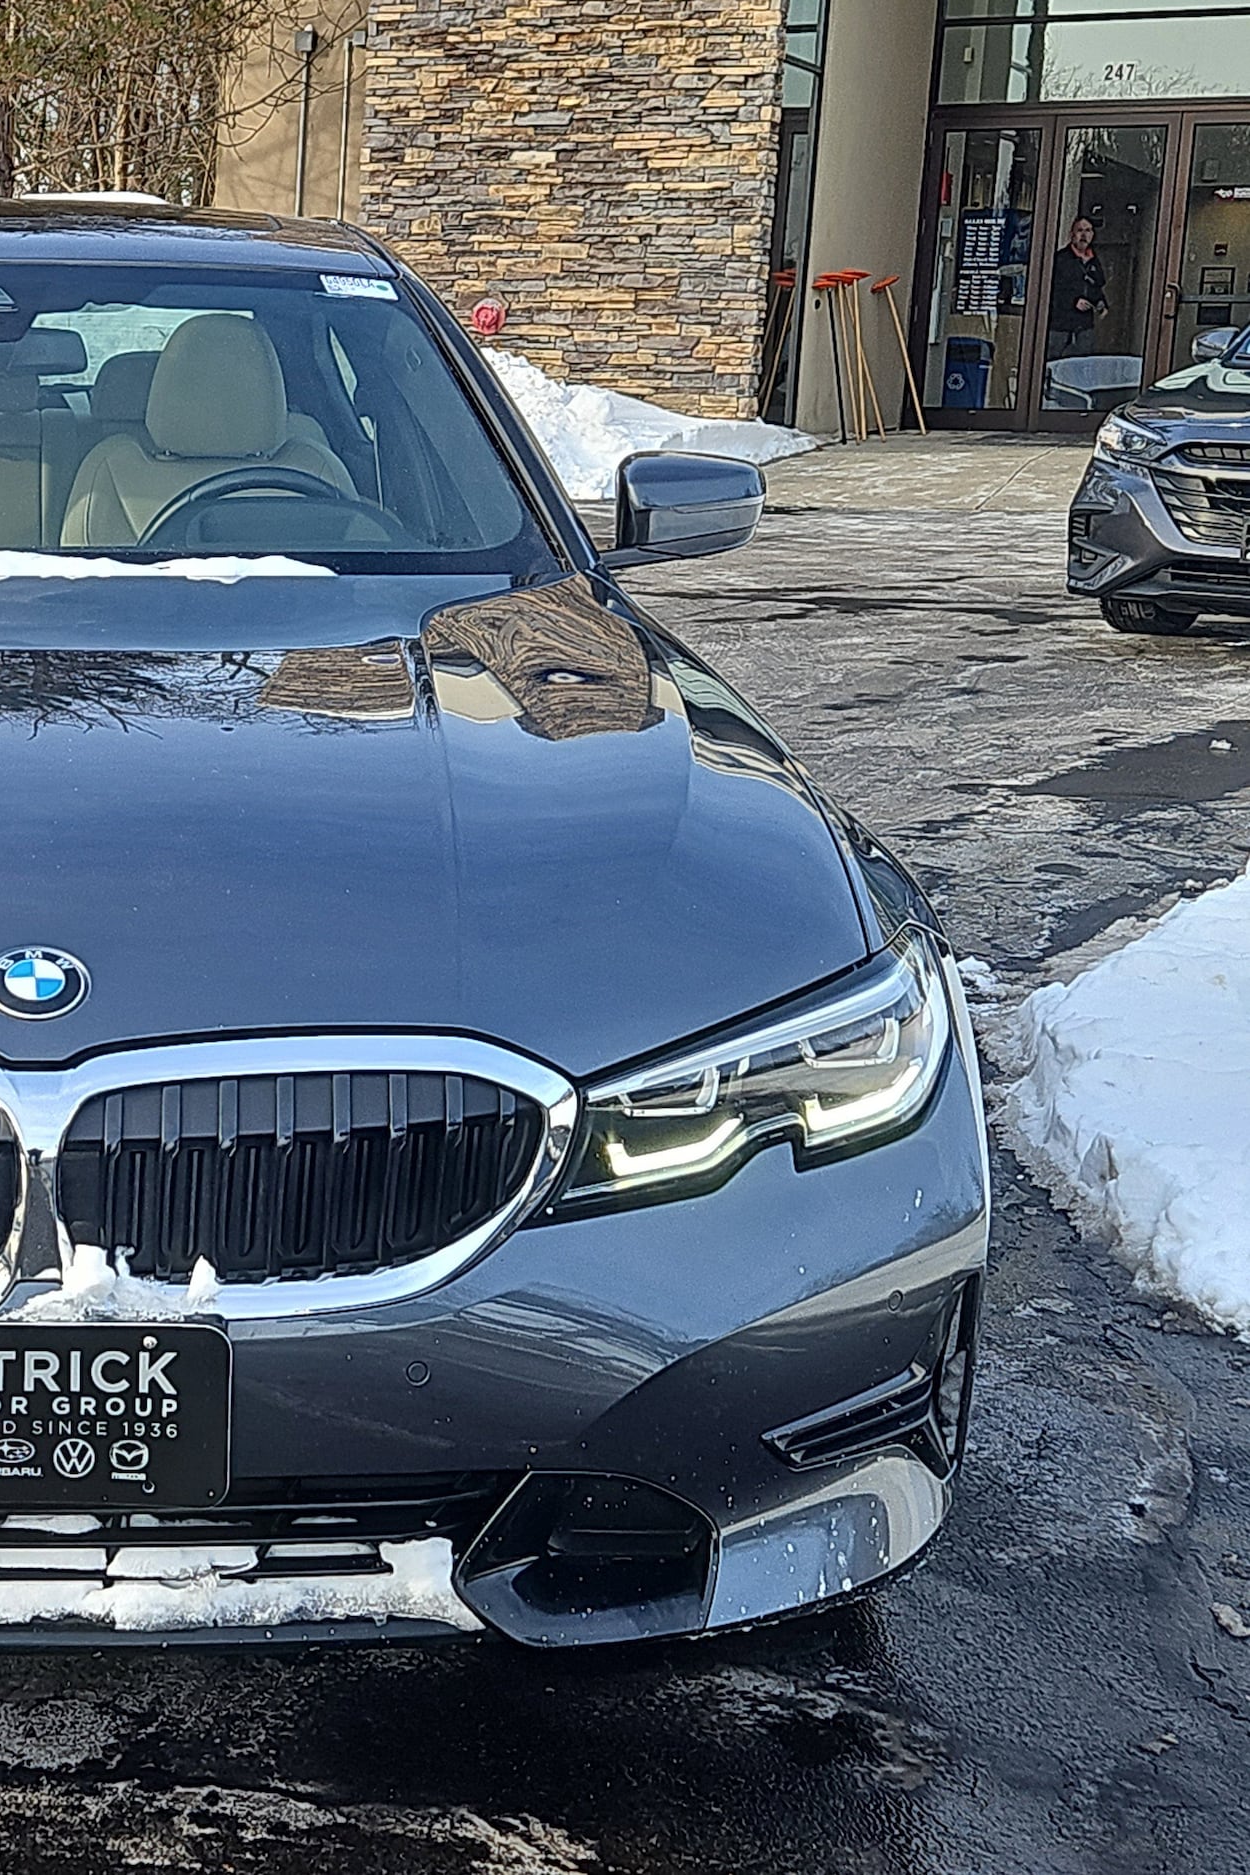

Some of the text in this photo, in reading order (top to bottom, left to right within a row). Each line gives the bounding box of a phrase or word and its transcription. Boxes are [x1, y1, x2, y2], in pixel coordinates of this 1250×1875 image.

[1104, 63, 1135, 81] 247
[51, 1398, 178, 1418] GROUP
[31, 1420, 108, 1436] SINCE
[122, 1421, 178, 1438] 1936
